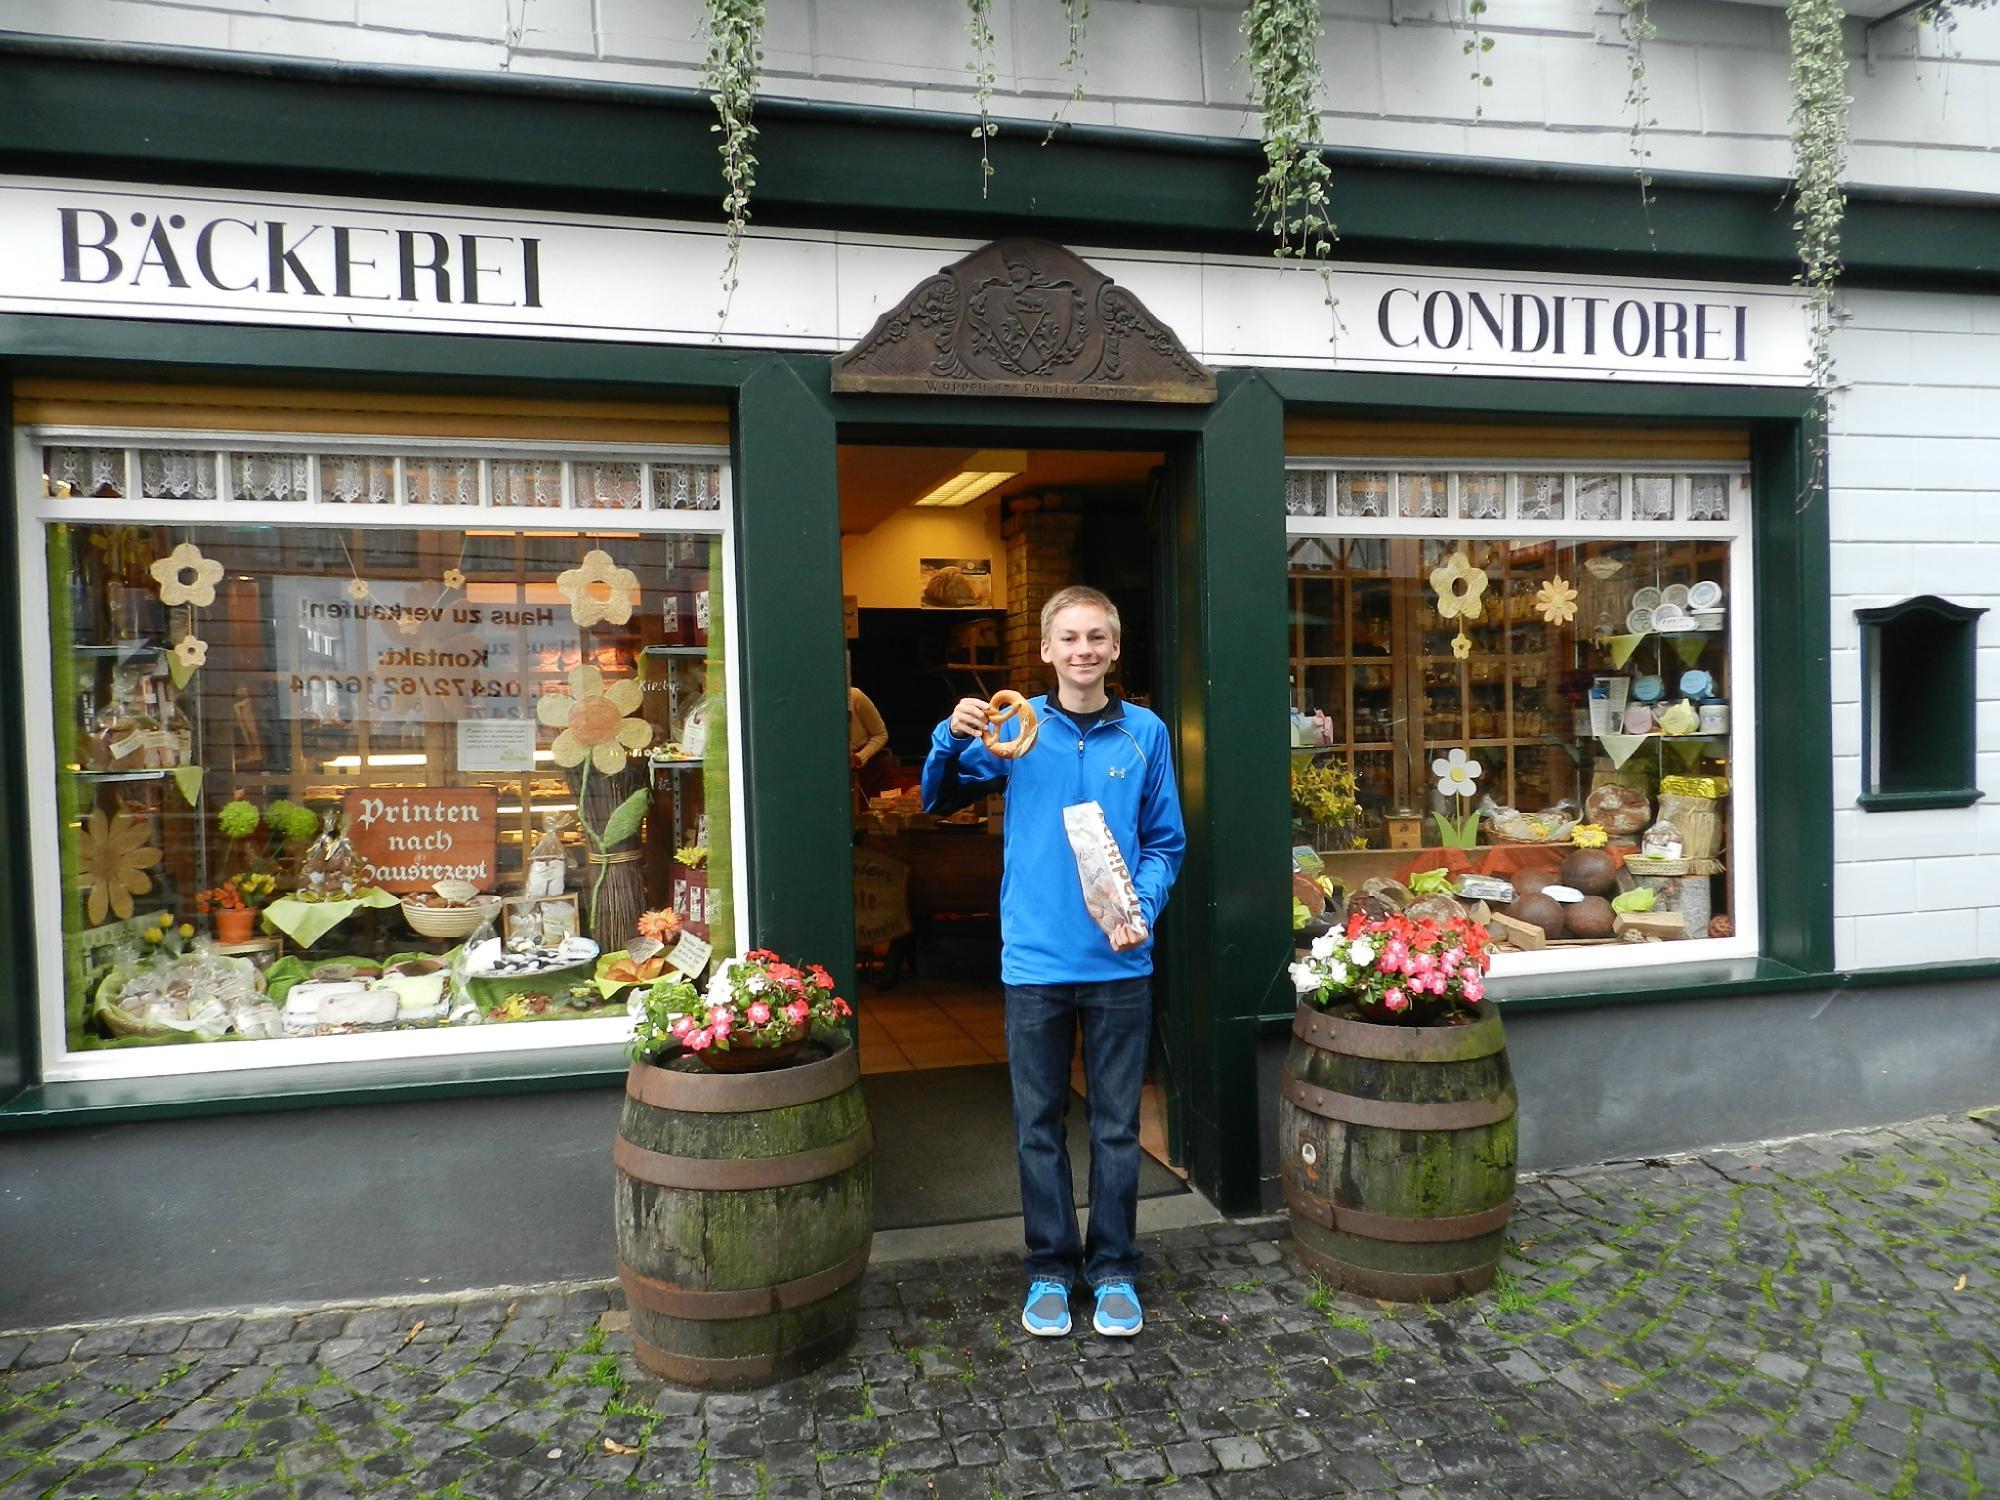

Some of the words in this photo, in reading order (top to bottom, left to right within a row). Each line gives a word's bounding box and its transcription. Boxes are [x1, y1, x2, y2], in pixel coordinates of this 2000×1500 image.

[57, 206, 544, 308] BÄCKEREI
[1377, 287, 1748, 362] CONDITOREI
[357, 797, 480, 831] Printen
[388, 829, 453, 853] nach
